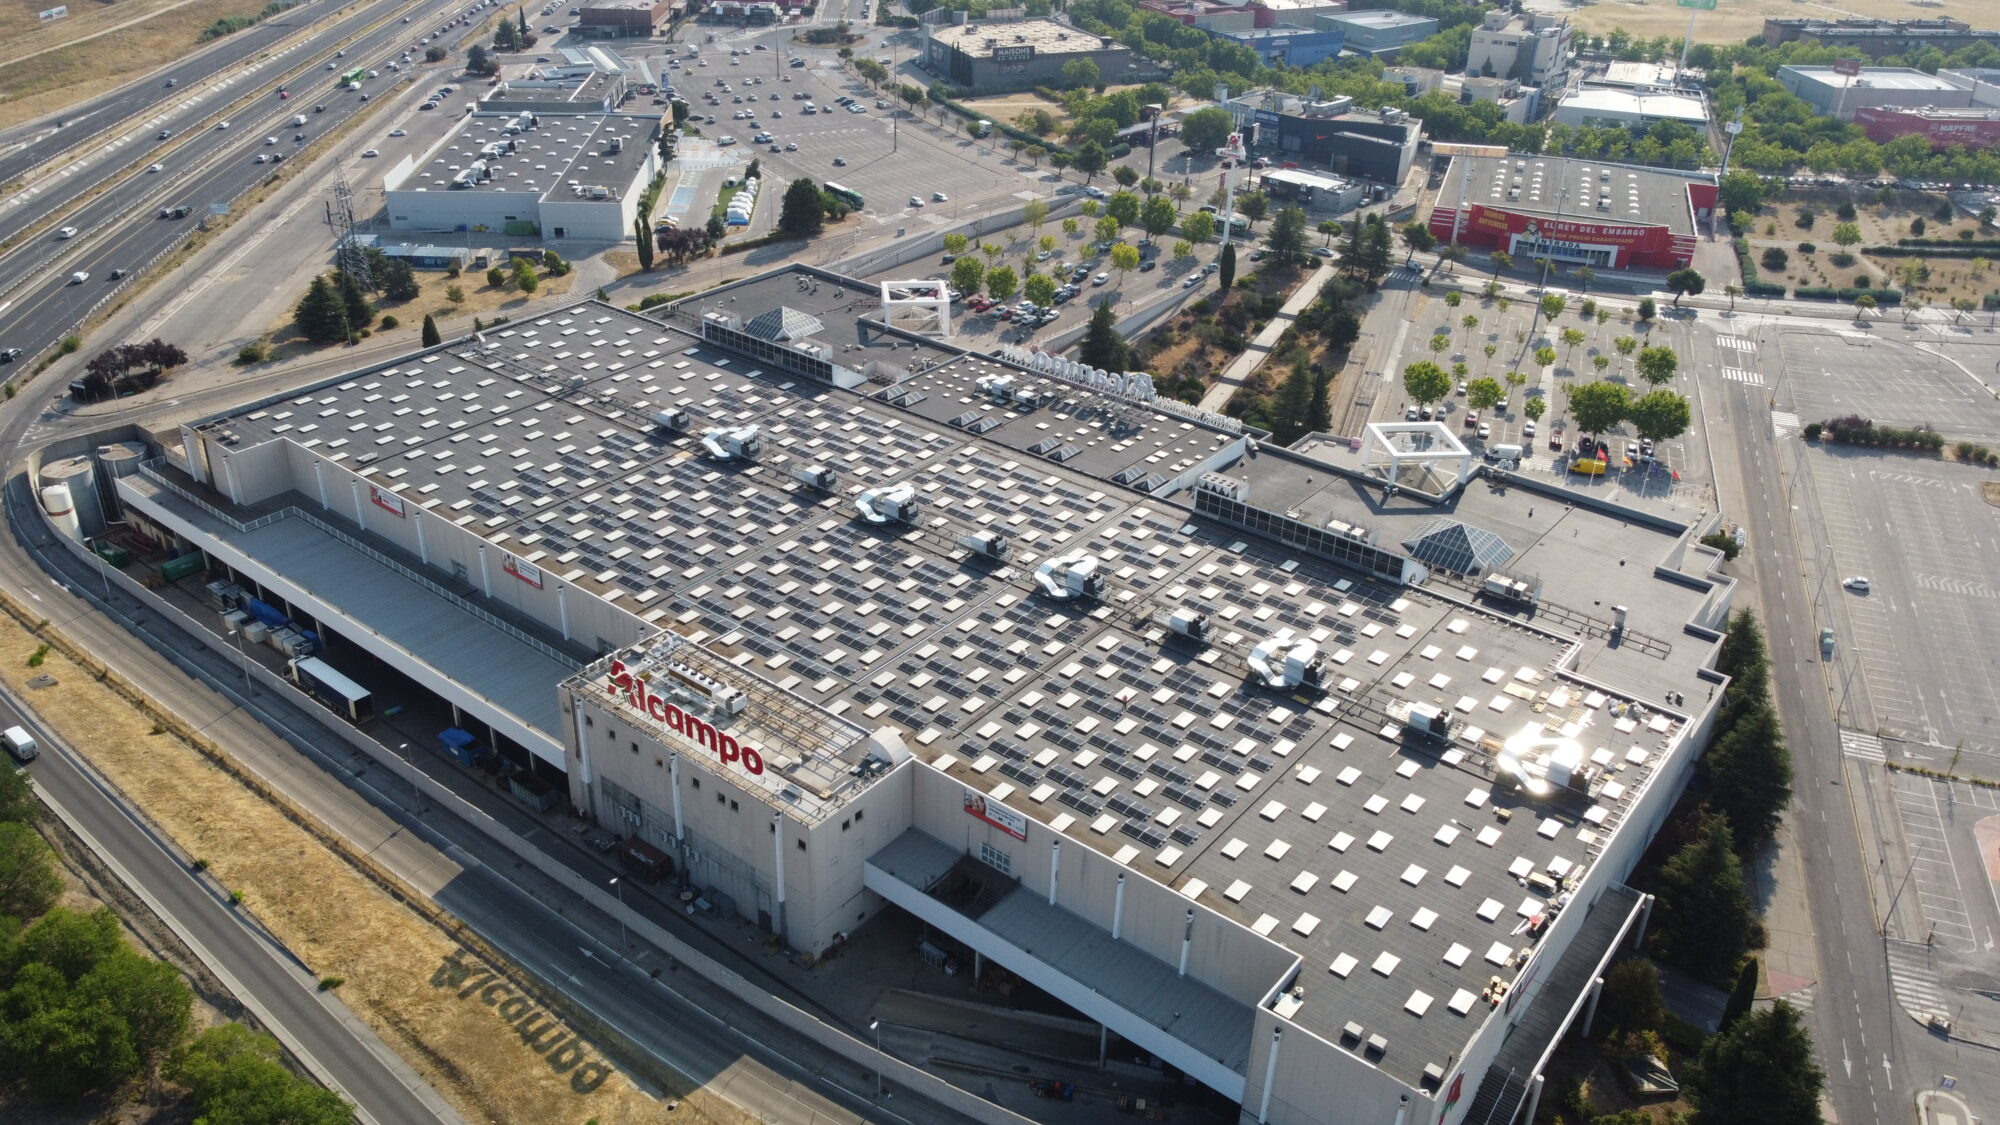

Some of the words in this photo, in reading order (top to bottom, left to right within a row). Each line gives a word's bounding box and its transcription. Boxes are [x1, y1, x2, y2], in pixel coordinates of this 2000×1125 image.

[998, 48, 1030, 56] MAISONS
[1940, 124, 1977, 132] MAPFRE
[1543, 221, 1555, 229] EL
[1557, 223, 1576, 231] REY
[1580, 226, 1597, 234] DEL
[1602, 227, 1646, 236] EMBARGO
[1534, 238, 1580, 249] ENTRADA
[606, 659, 765, 776] Alcampo
